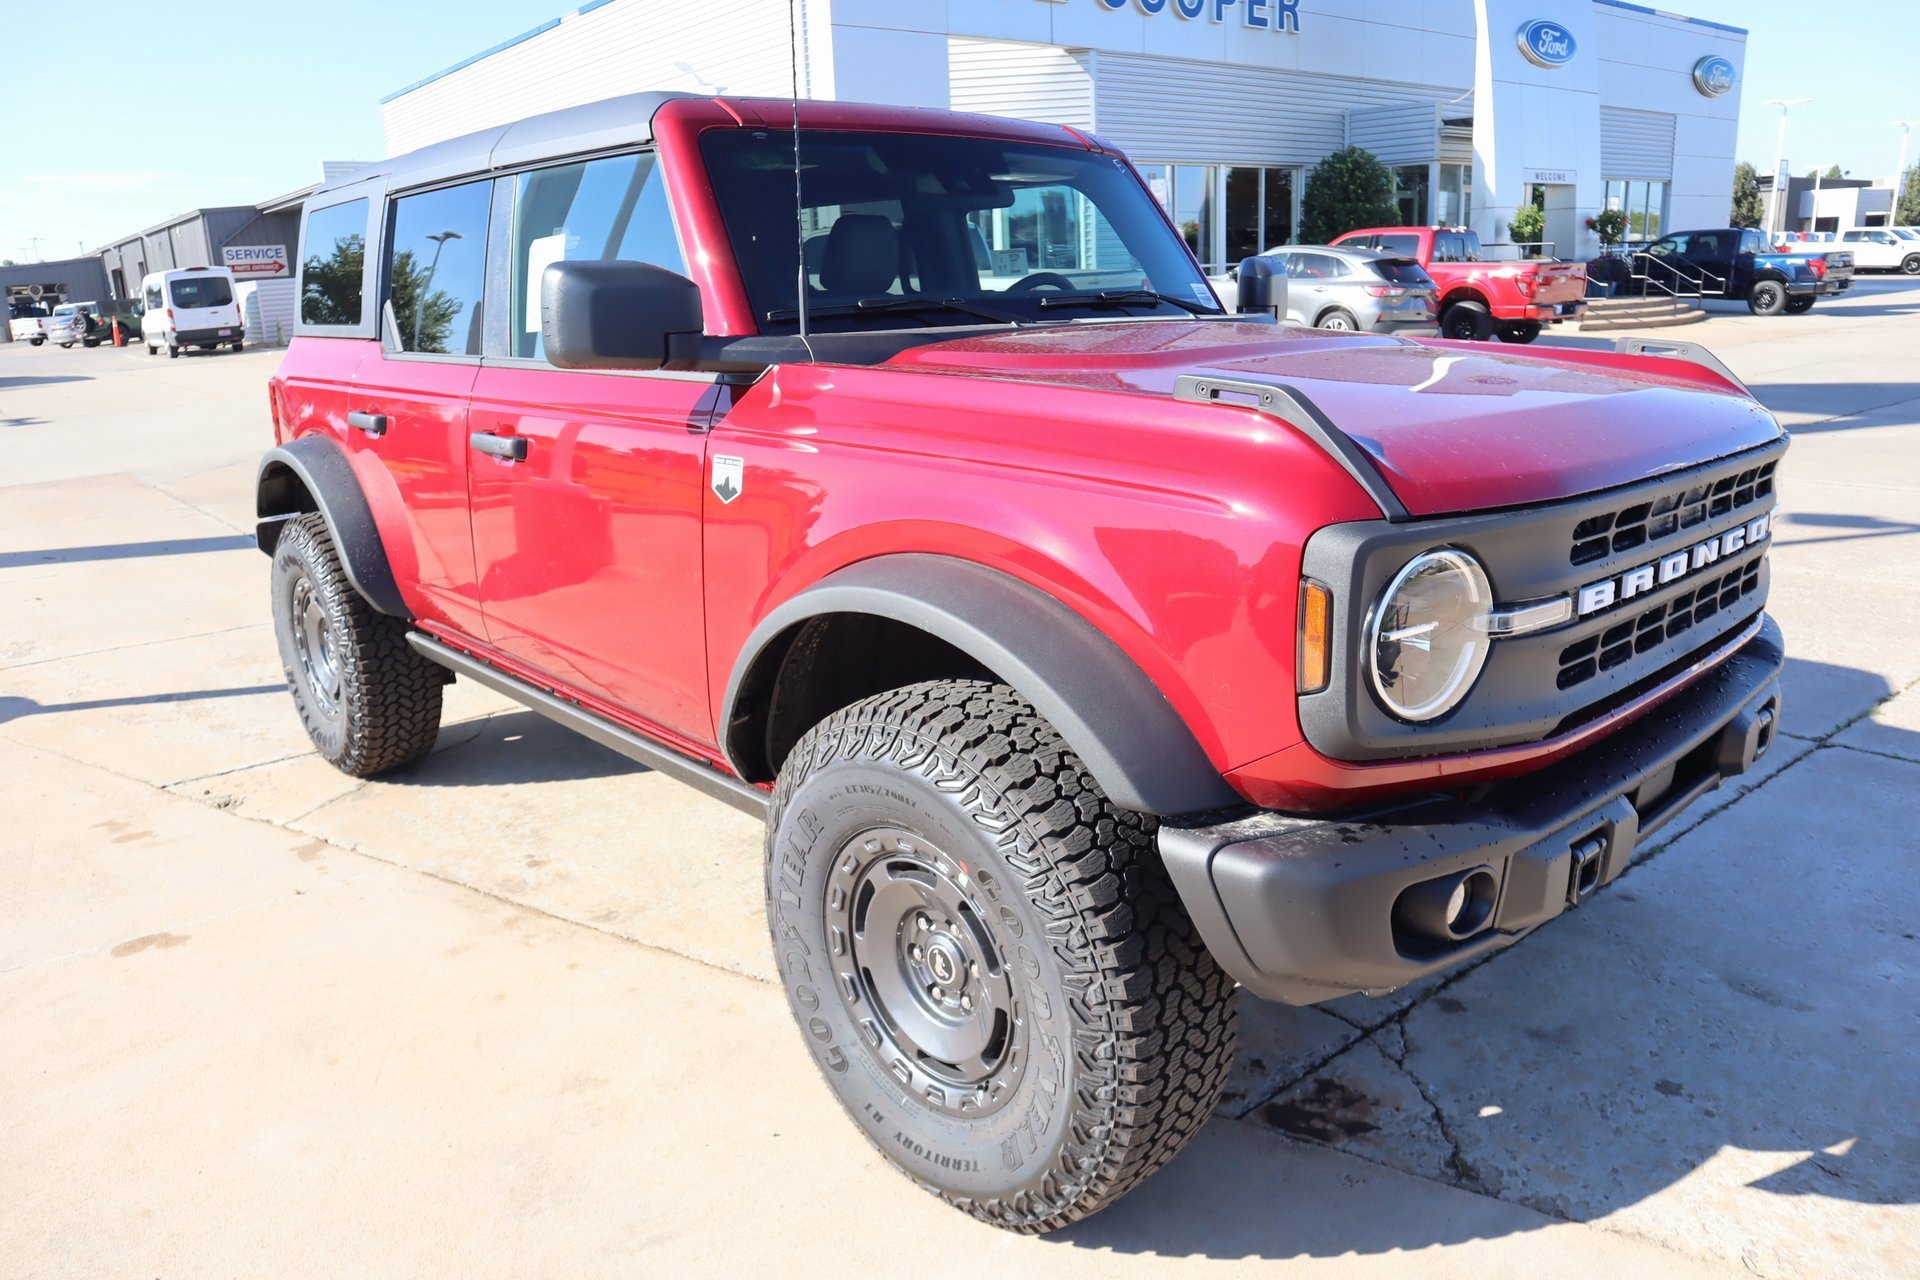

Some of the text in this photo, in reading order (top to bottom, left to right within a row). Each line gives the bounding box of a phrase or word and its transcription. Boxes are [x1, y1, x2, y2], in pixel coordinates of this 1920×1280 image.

[1099, 0, 1300, 33] OPER
[1539, 28, 1568, 56] Ford
[1710, 65, 1732, 86] Ford
[1534, 172, 1566, 182] WELCOME
[226, 248, 283, 260] SERVICE
[1579, 515, 1768, 615] BRONCO
[775, 806, 848, 1074] GOODYEAR
[976, 868, 1064, 1173] GOODYEAR
[864, 1103, 980, 1173] TERRITORY RT
